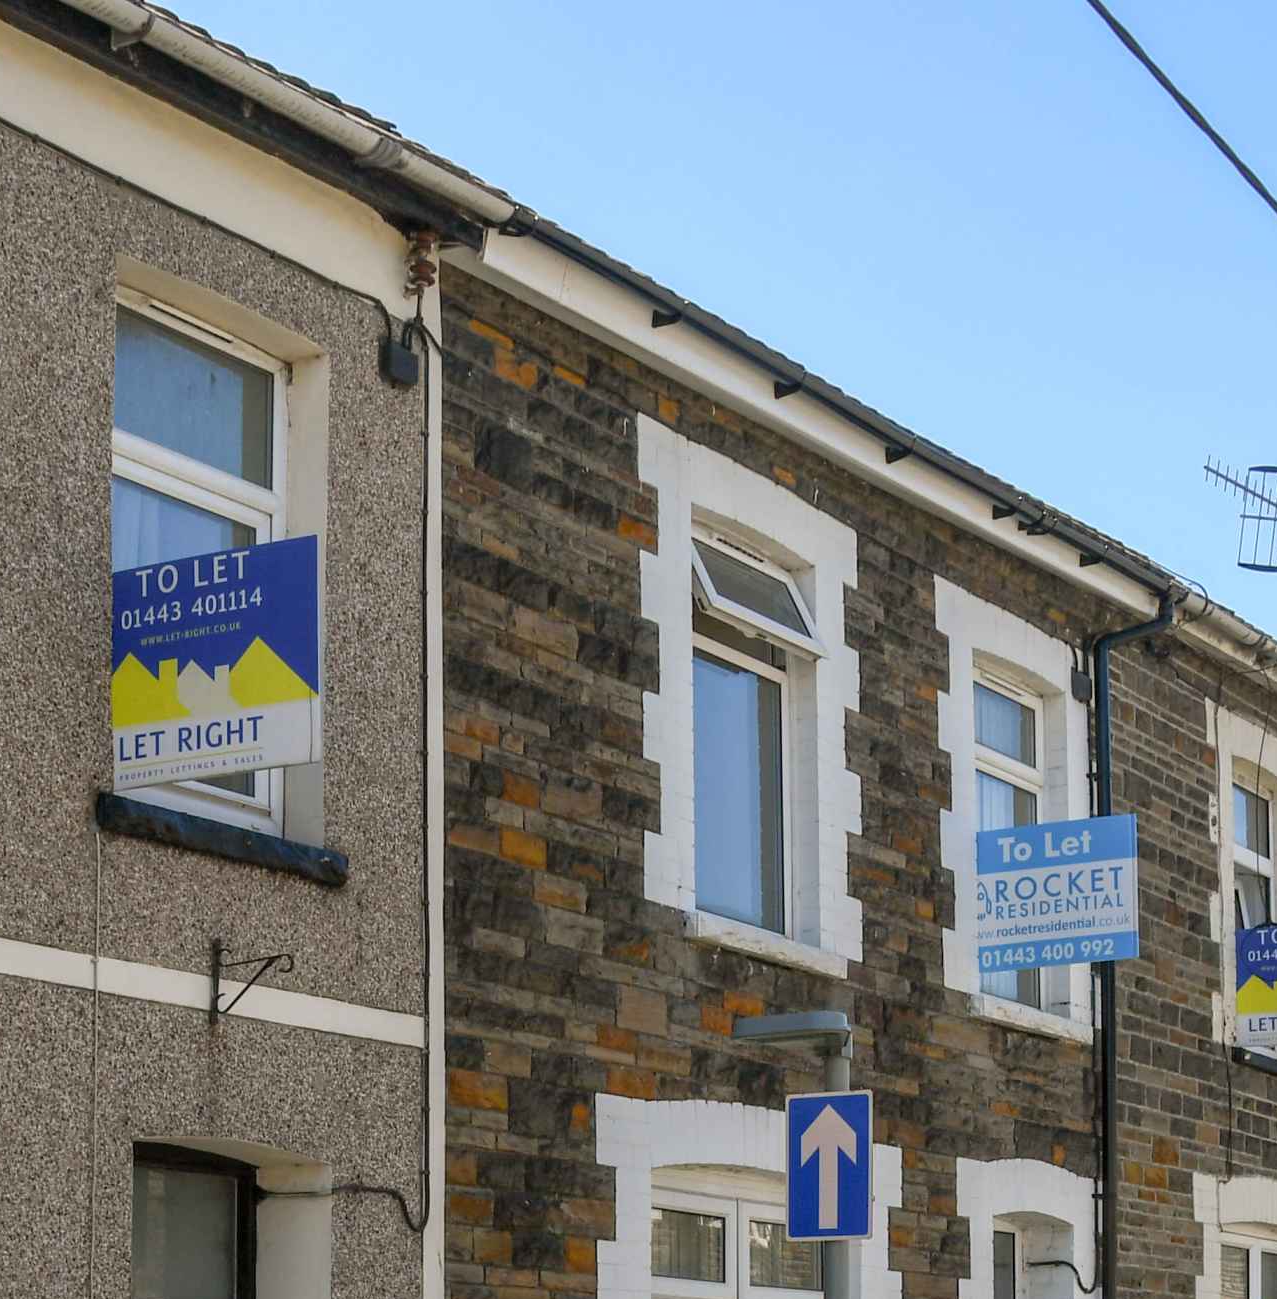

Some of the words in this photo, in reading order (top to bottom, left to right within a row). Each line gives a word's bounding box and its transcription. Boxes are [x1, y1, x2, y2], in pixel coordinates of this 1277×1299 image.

[135, 564, 179, 598] TO
[193, 551, 250, 588] LET
[121, 601, 182, 631] 01443
[191, 586, 263, 617] 401114
[119, 730, 166, 762] LET
[178, 716, 264, 753] RIGHT
[119, 768, 164, 781] PROPERTY
[170, 761, 215, 775] LETTINGS
[997, 837, 1033, 864] To
[1044, 830, 1092, 858] Let
[995, 867, 1123, 903] ROCKET
[995, 894, 1124, 921] RESIDENTIAL
[981, 946, 1035, 968] 01443
[1041, 943, 1074, 961] 400
[1080, 938, 1115, 957] 992
